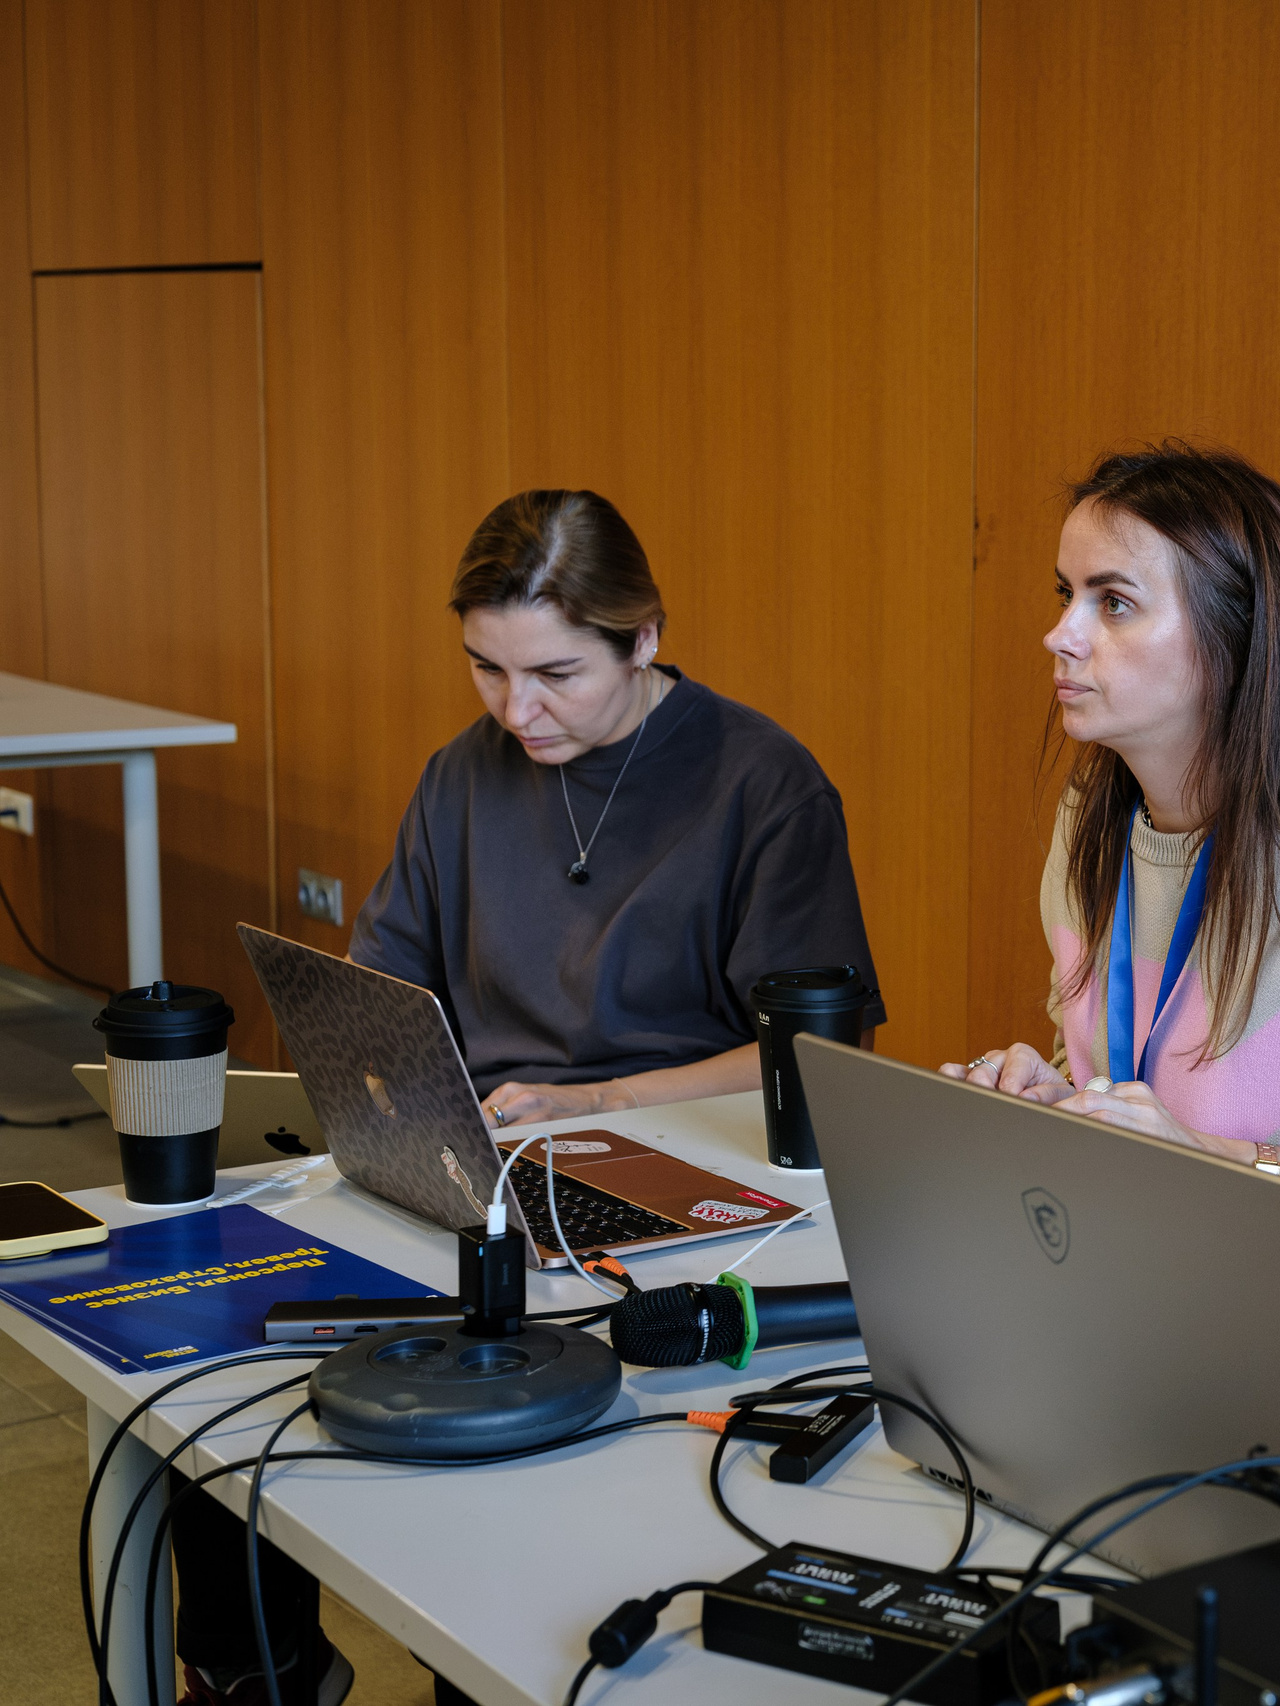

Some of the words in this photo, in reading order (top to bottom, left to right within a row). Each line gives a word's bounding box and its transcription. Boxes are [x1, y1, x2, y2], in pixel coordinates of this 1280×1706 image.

[224, 1247, 330, 1269] Тревел,
[48, 1266, 229, 1305] Страхование
[186, 1257, 327, 1288] Персонал,
[85, 1285, 191, 1309] Бизнес
